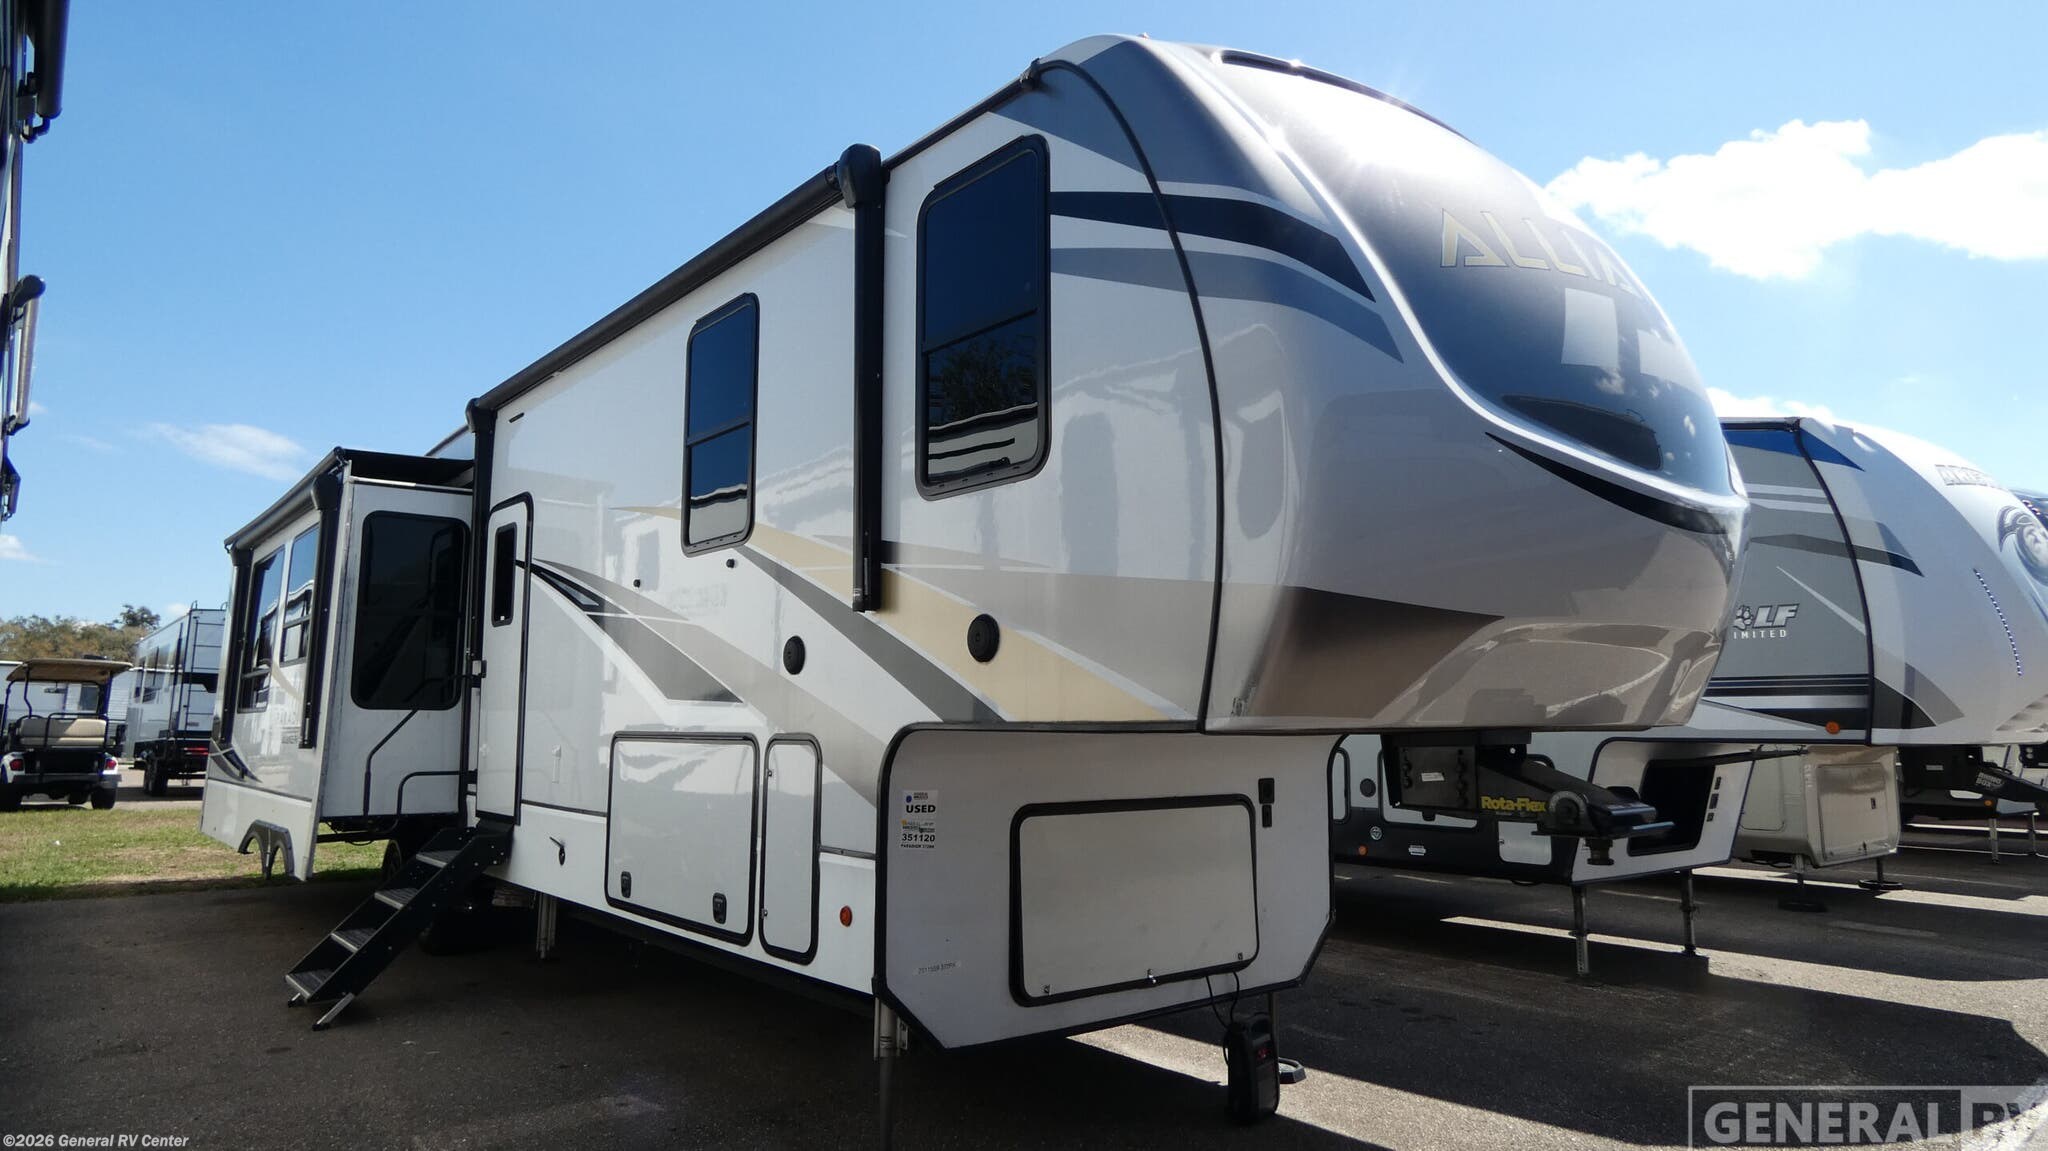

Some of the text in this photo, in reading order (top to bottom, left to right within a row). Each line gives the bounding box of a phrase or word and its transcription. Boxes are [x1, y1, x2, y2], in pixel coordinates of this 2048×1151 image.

[906, 804, 936, 814] USED
[1480, 796, 1546, 812] Rota-Flex
[901, 833, 936, 842] 351120
